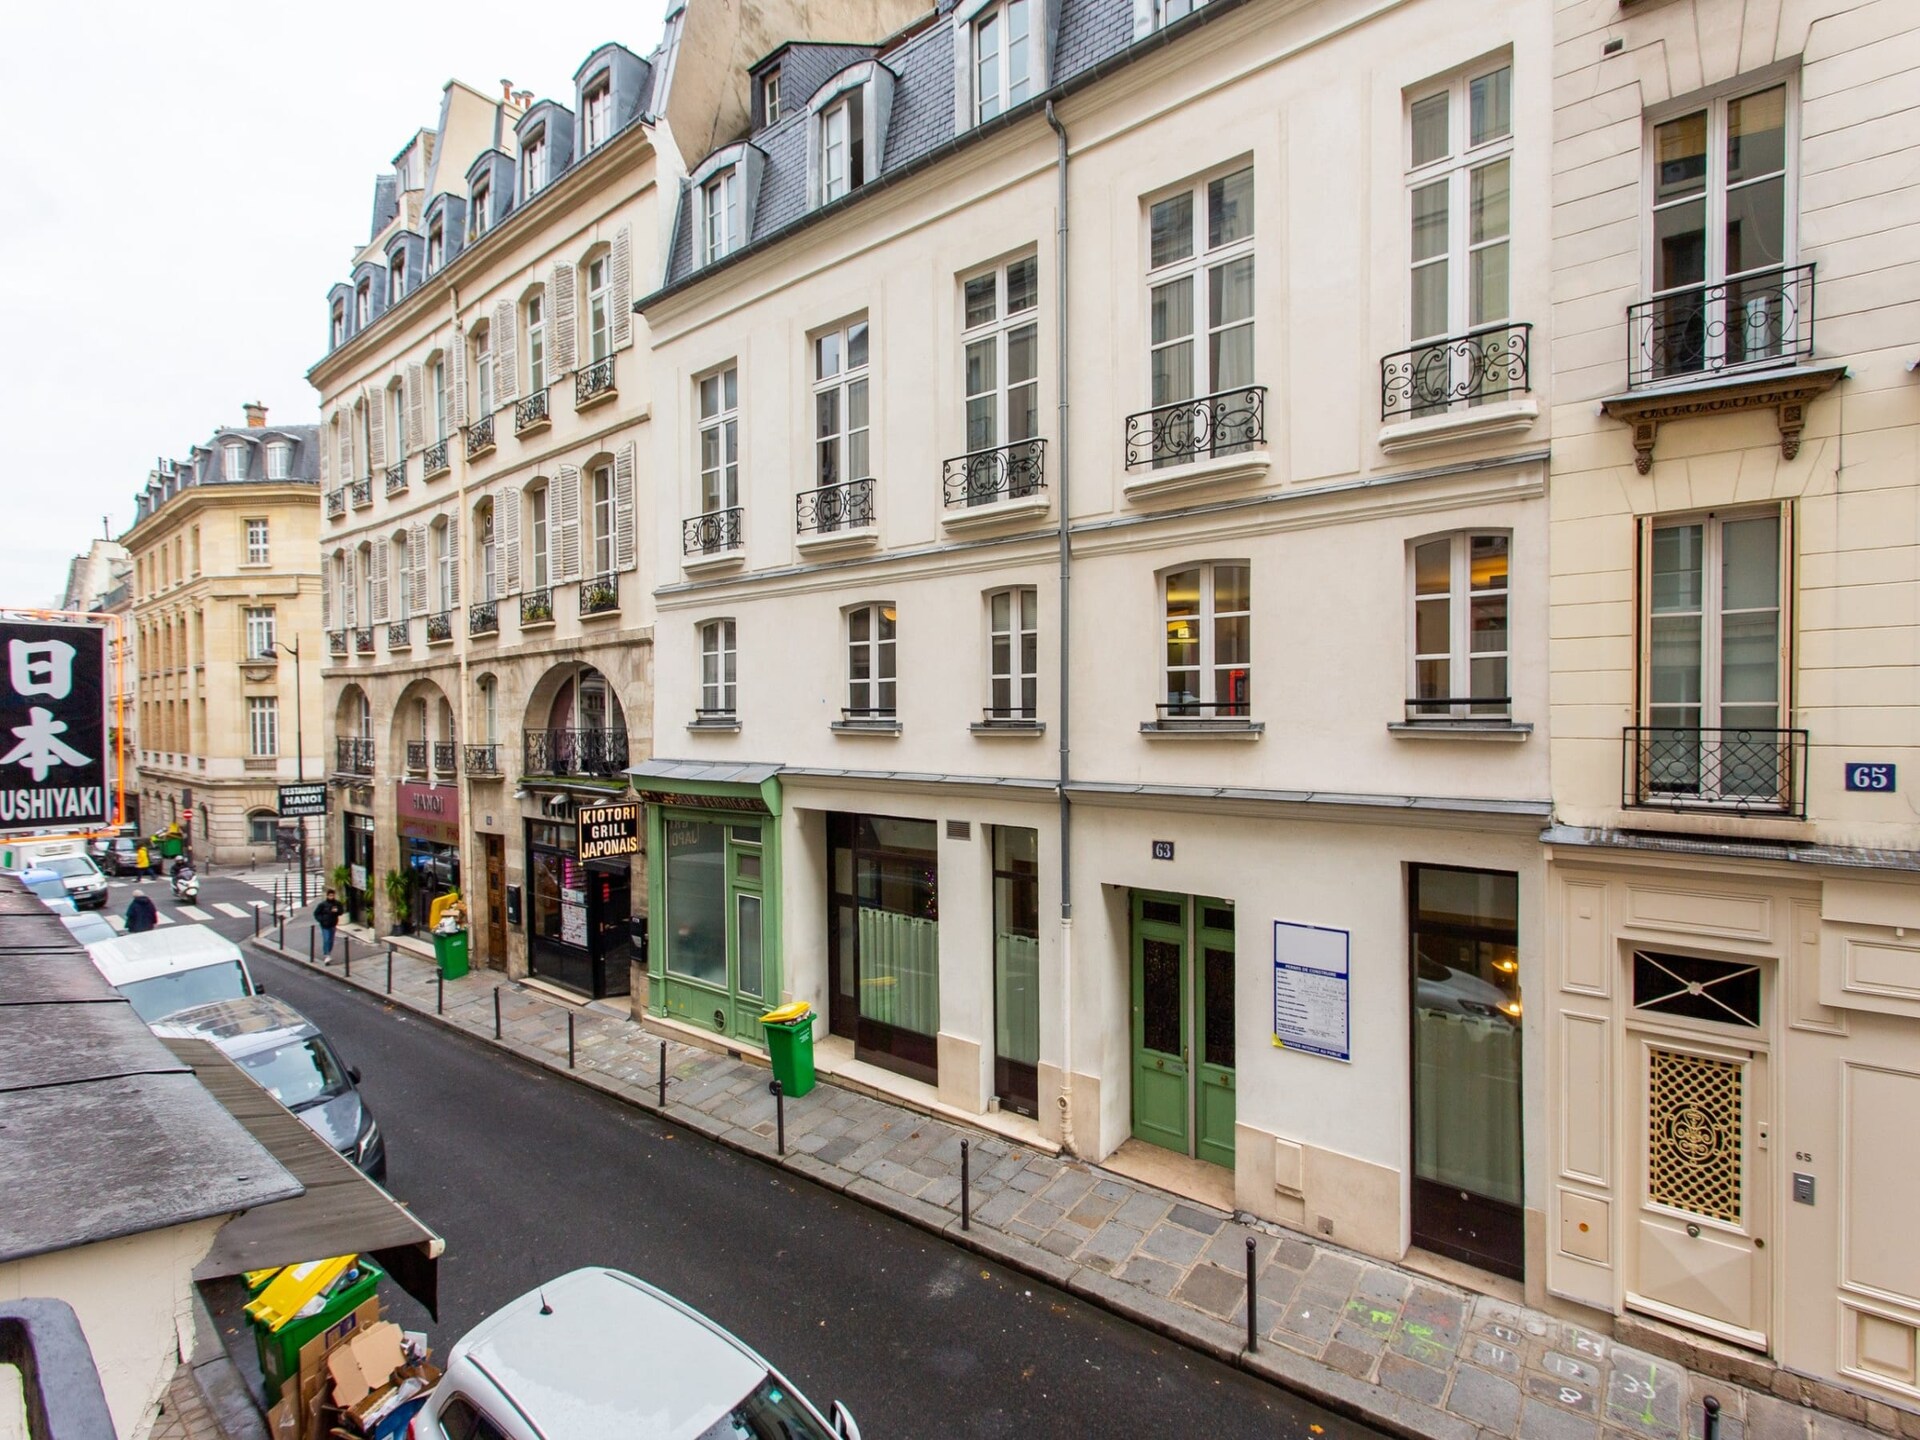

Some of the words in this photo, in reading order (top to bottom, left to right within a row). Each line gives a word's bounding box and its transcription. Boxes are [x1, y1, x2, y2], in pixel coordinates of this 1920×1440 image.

[0, 639, 95, 782] 日本
[1853, 767, 1888, 789] 65
[281, 786, 325, 795] RESTAURANT
[286, 795, 321, 805] HANOI
[282, 806, 325, 815] VIETNAMIEN
[582, 806, 635, 824] KIOTORI
[591, 823, 627, 839] GRILL
[582, 837, 637, 859] JAPONAIS
[1156, 843, 1171, 858] 63
[1796, 1151, 1813, 1163] 65
[1559, 1387, 1582, 1404] 8
